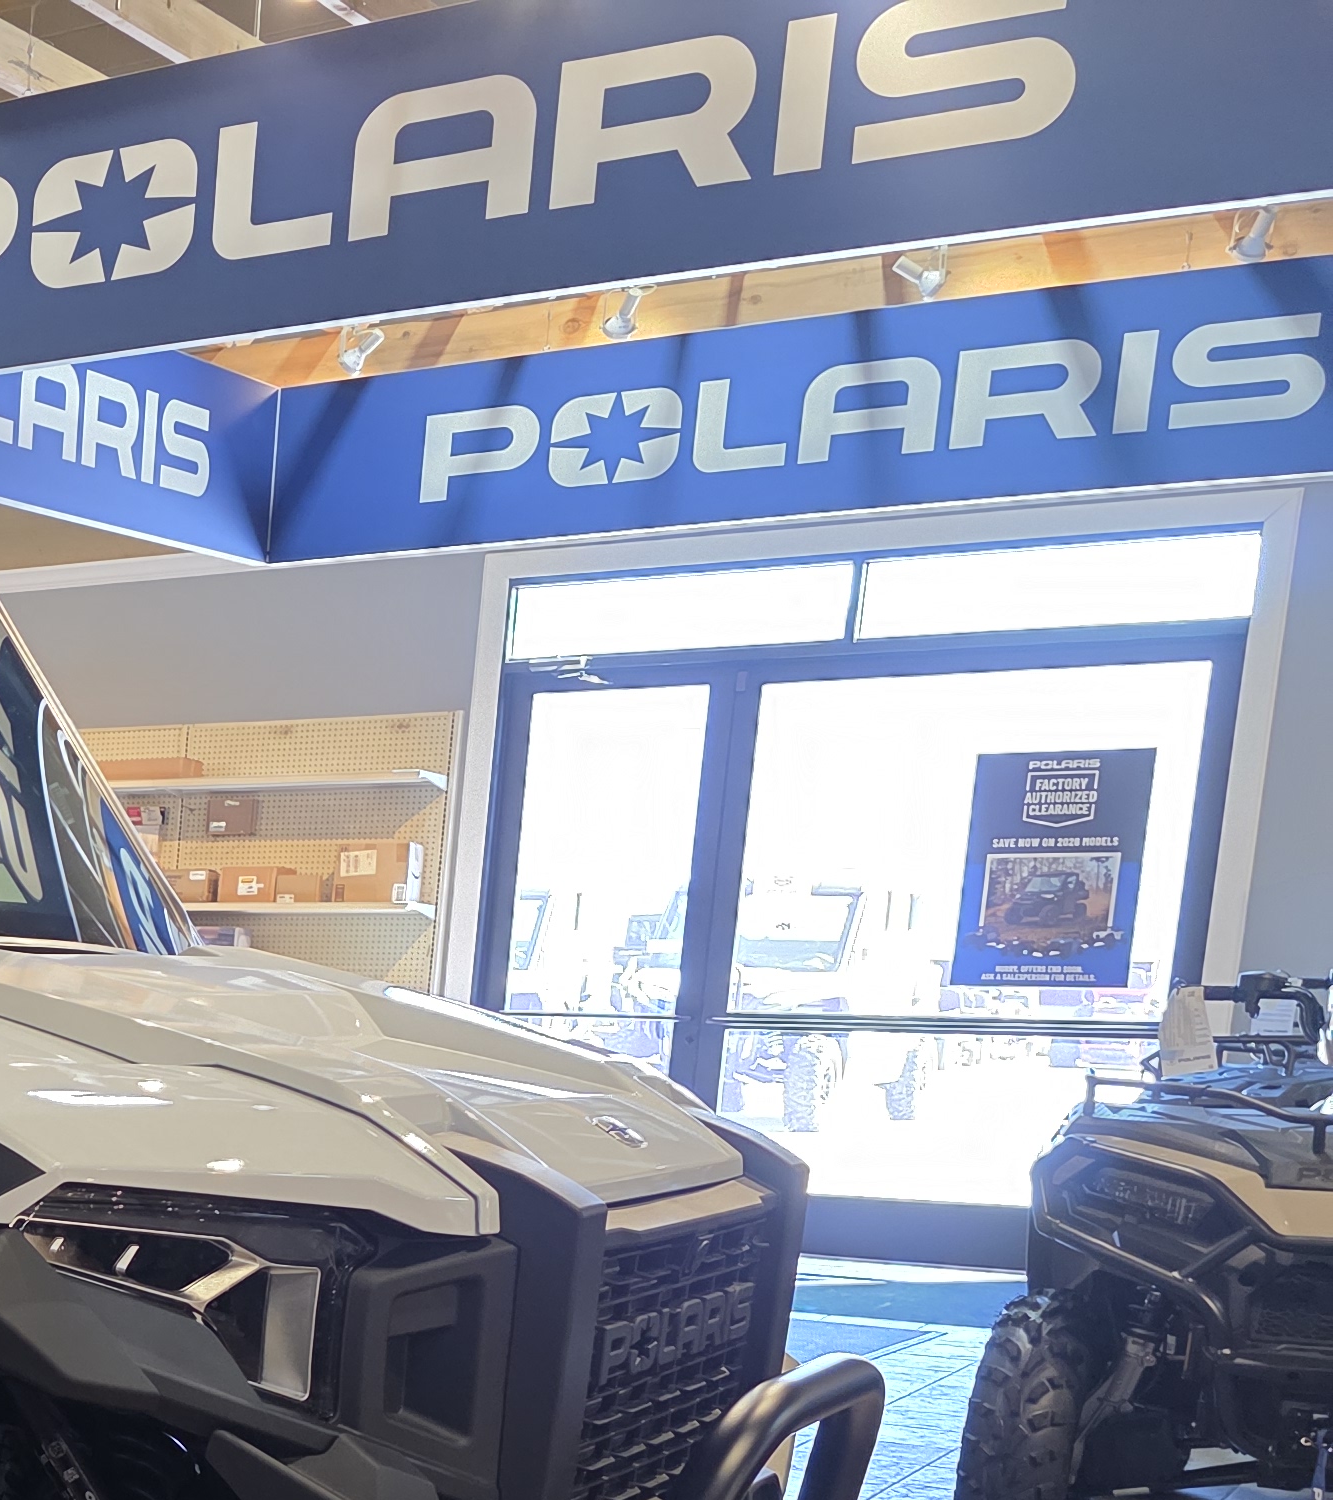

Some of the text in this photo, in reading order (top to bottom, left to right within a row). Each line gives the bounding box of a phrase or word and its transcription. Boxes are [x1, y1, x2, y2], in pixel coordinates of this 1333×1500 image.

[419, 314, 1325, 503] POLARIS
[1029, 759, 1100, 769] POLARIS
[1035, 778, 1089, 790] FACTORY
[1024, 791, 1098, 803] AUTHORIZED
[1029, 804, 1090, 815] CLEARANCE
[992, 838, 1016, 848] SAVE
[1018, 838, 1040, 847] NOW
[1042, 838, 1055, 847] ON
[1082, 837, 1119, 847] MODELS
[598, 1282, 755, 1387] POLARIS
